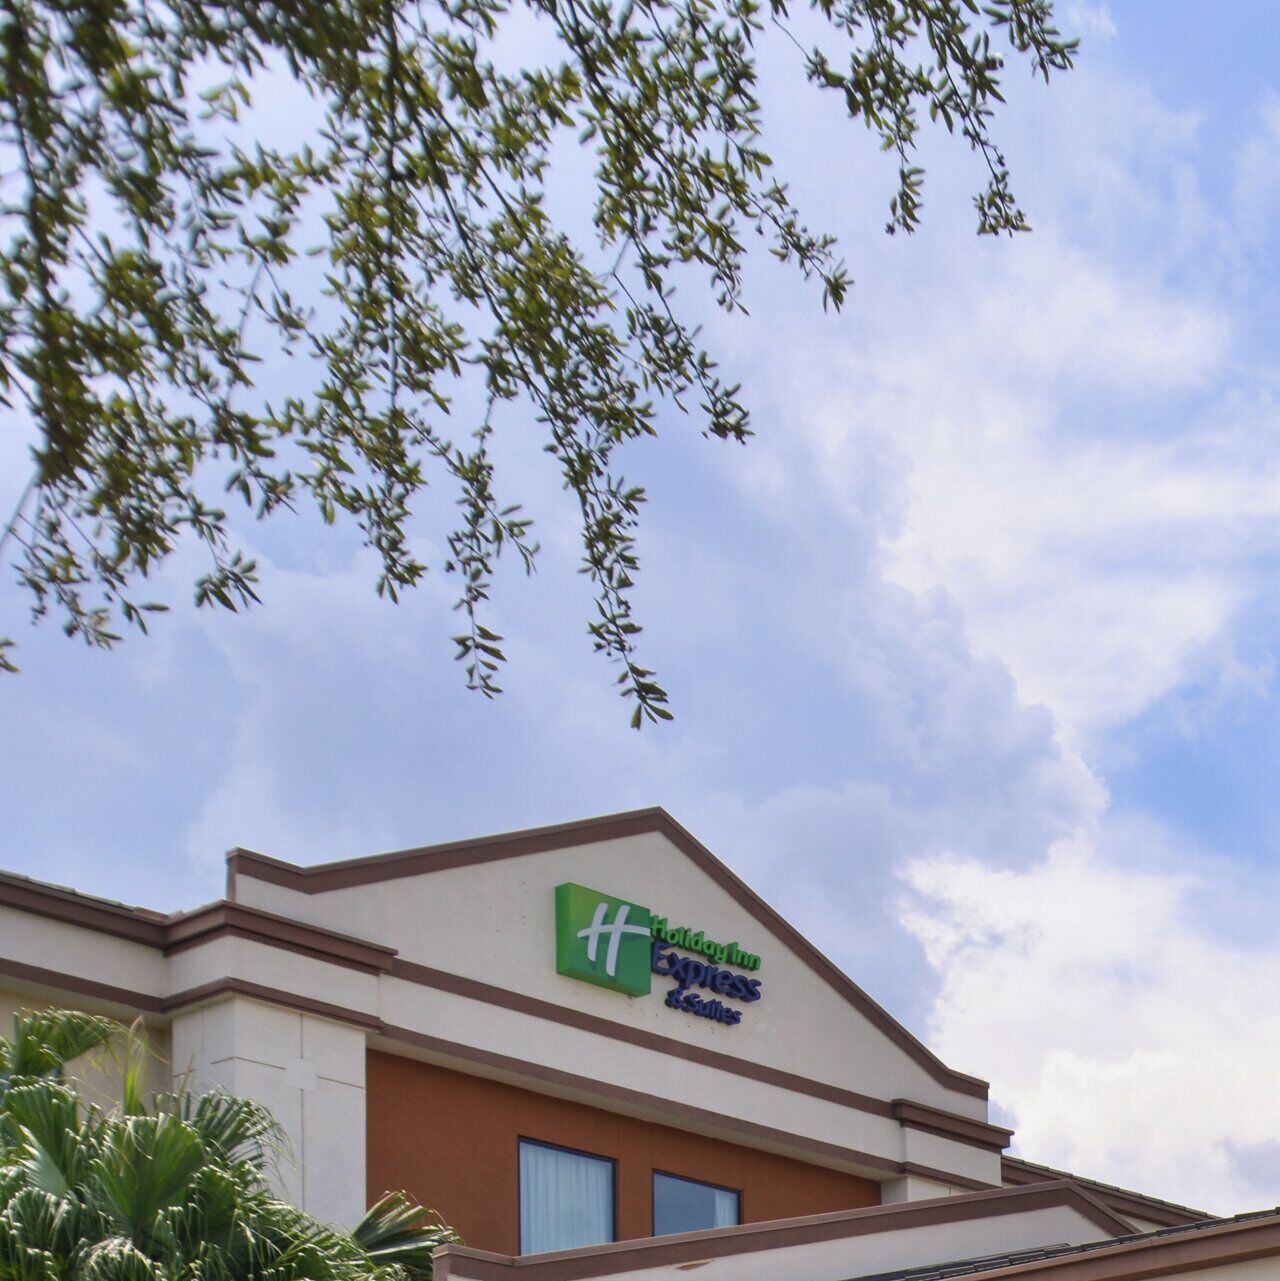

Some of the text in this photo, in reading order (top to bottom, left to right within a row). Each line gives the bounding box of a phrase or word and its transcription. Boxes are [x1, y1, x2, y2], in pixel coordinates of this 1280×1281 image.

[651, 915, 762, 971] Holiday Inn
[651, 939, 762, 1002] Express
[664, 988, 742, 1026] & Suites
